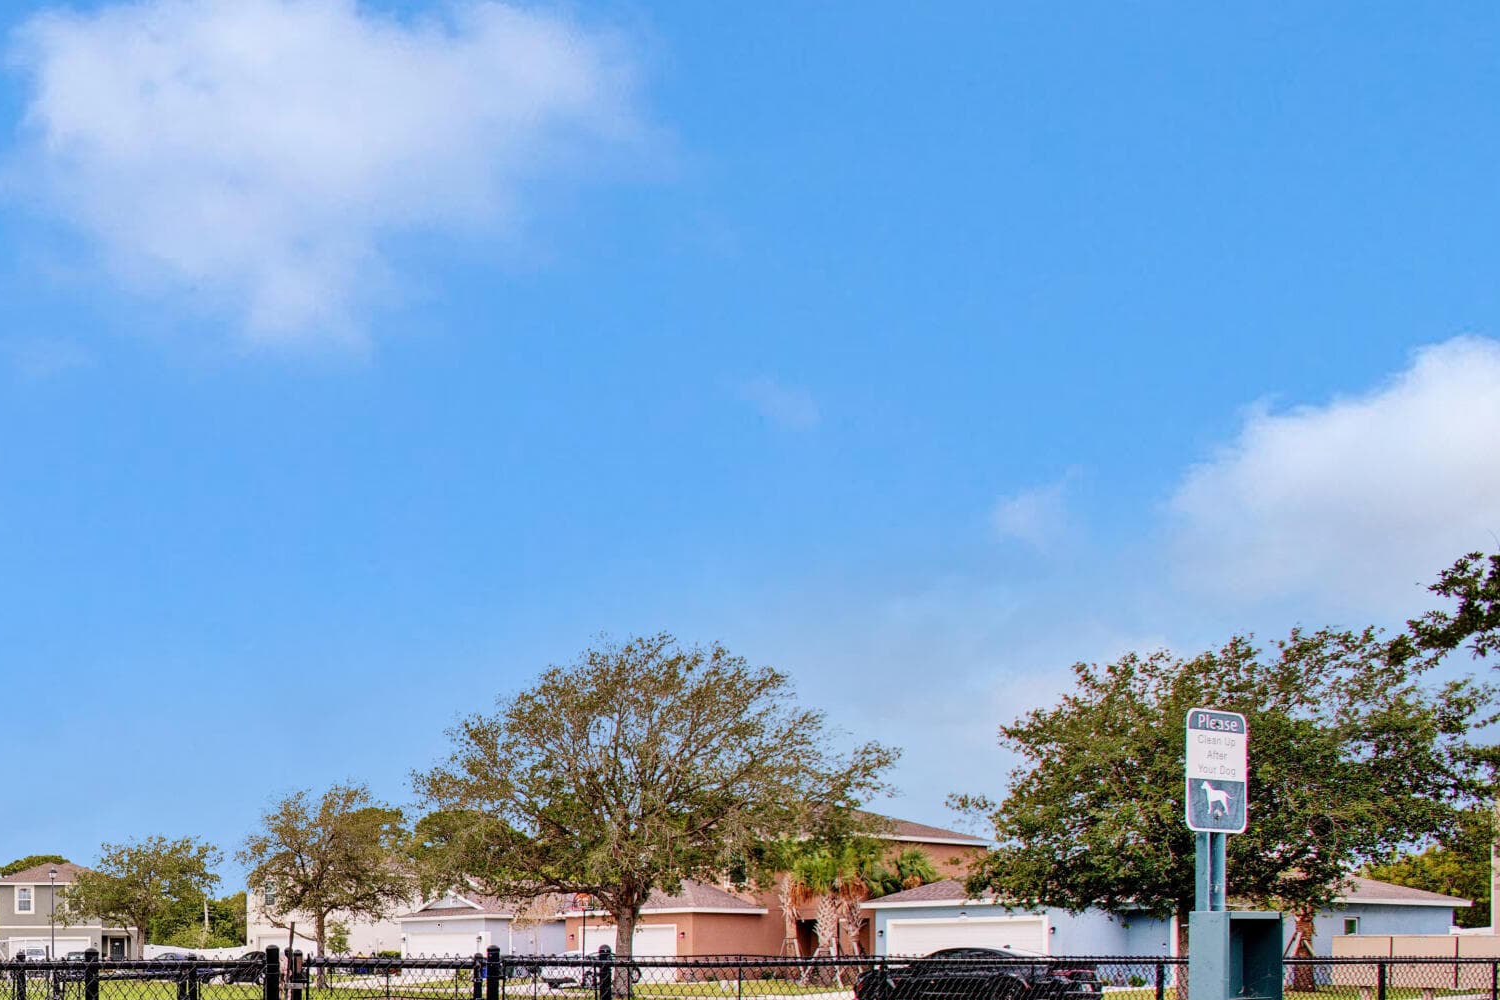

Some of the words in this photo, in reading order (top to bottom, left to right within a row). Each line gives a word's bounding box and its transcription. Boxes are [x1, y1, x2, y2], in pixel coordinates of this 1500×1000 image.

[1197, 714, 1238, 732] Please
[1197, 734, 1221, 746] Clean
[1224, 737, 1236, 748] Up
[1206, 750, 1228, 761] After
[1198, 764, 1217, 774] Your
[1219, 765, 1236, 777] Dog
